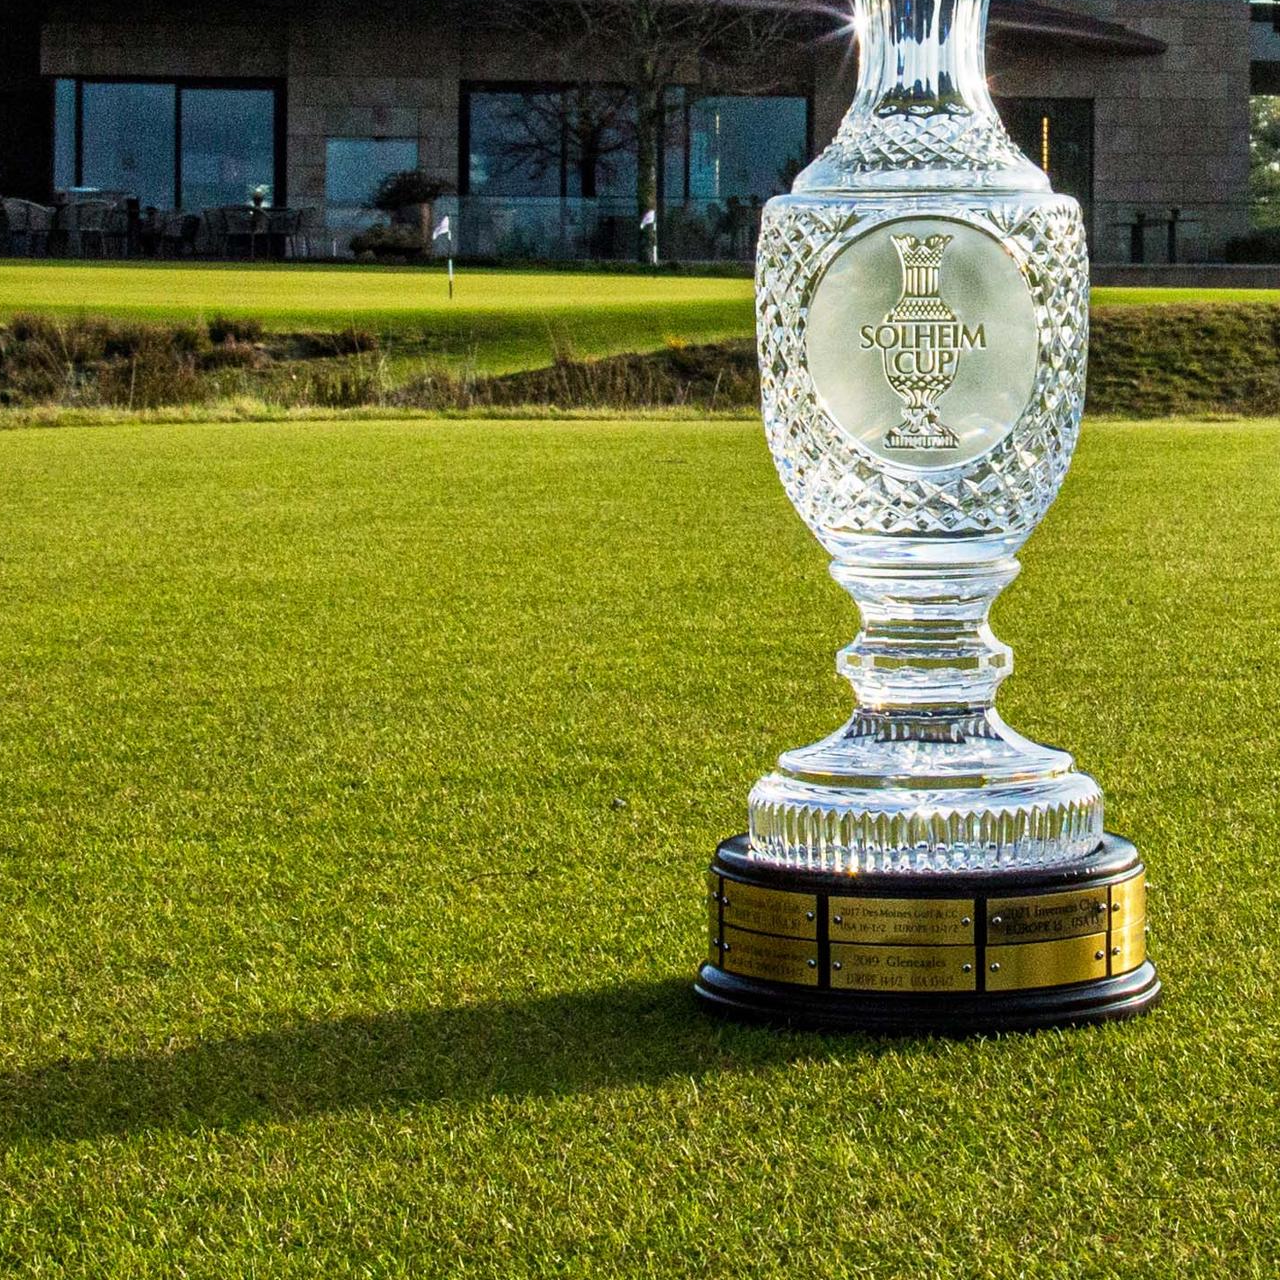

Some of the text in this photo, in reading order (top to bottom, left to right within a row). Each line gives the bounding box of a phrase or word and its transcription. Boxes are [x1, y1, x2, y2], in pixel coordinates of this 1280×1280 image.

[860, 323, 986, 349] SOLHEIM
[894, 351, 954, 375] CUP
[879, 908, 912, 919] Moines
[1006, 920, 1049, 935] EUROPE
[886, 955, 947, 971] Gleneagles
